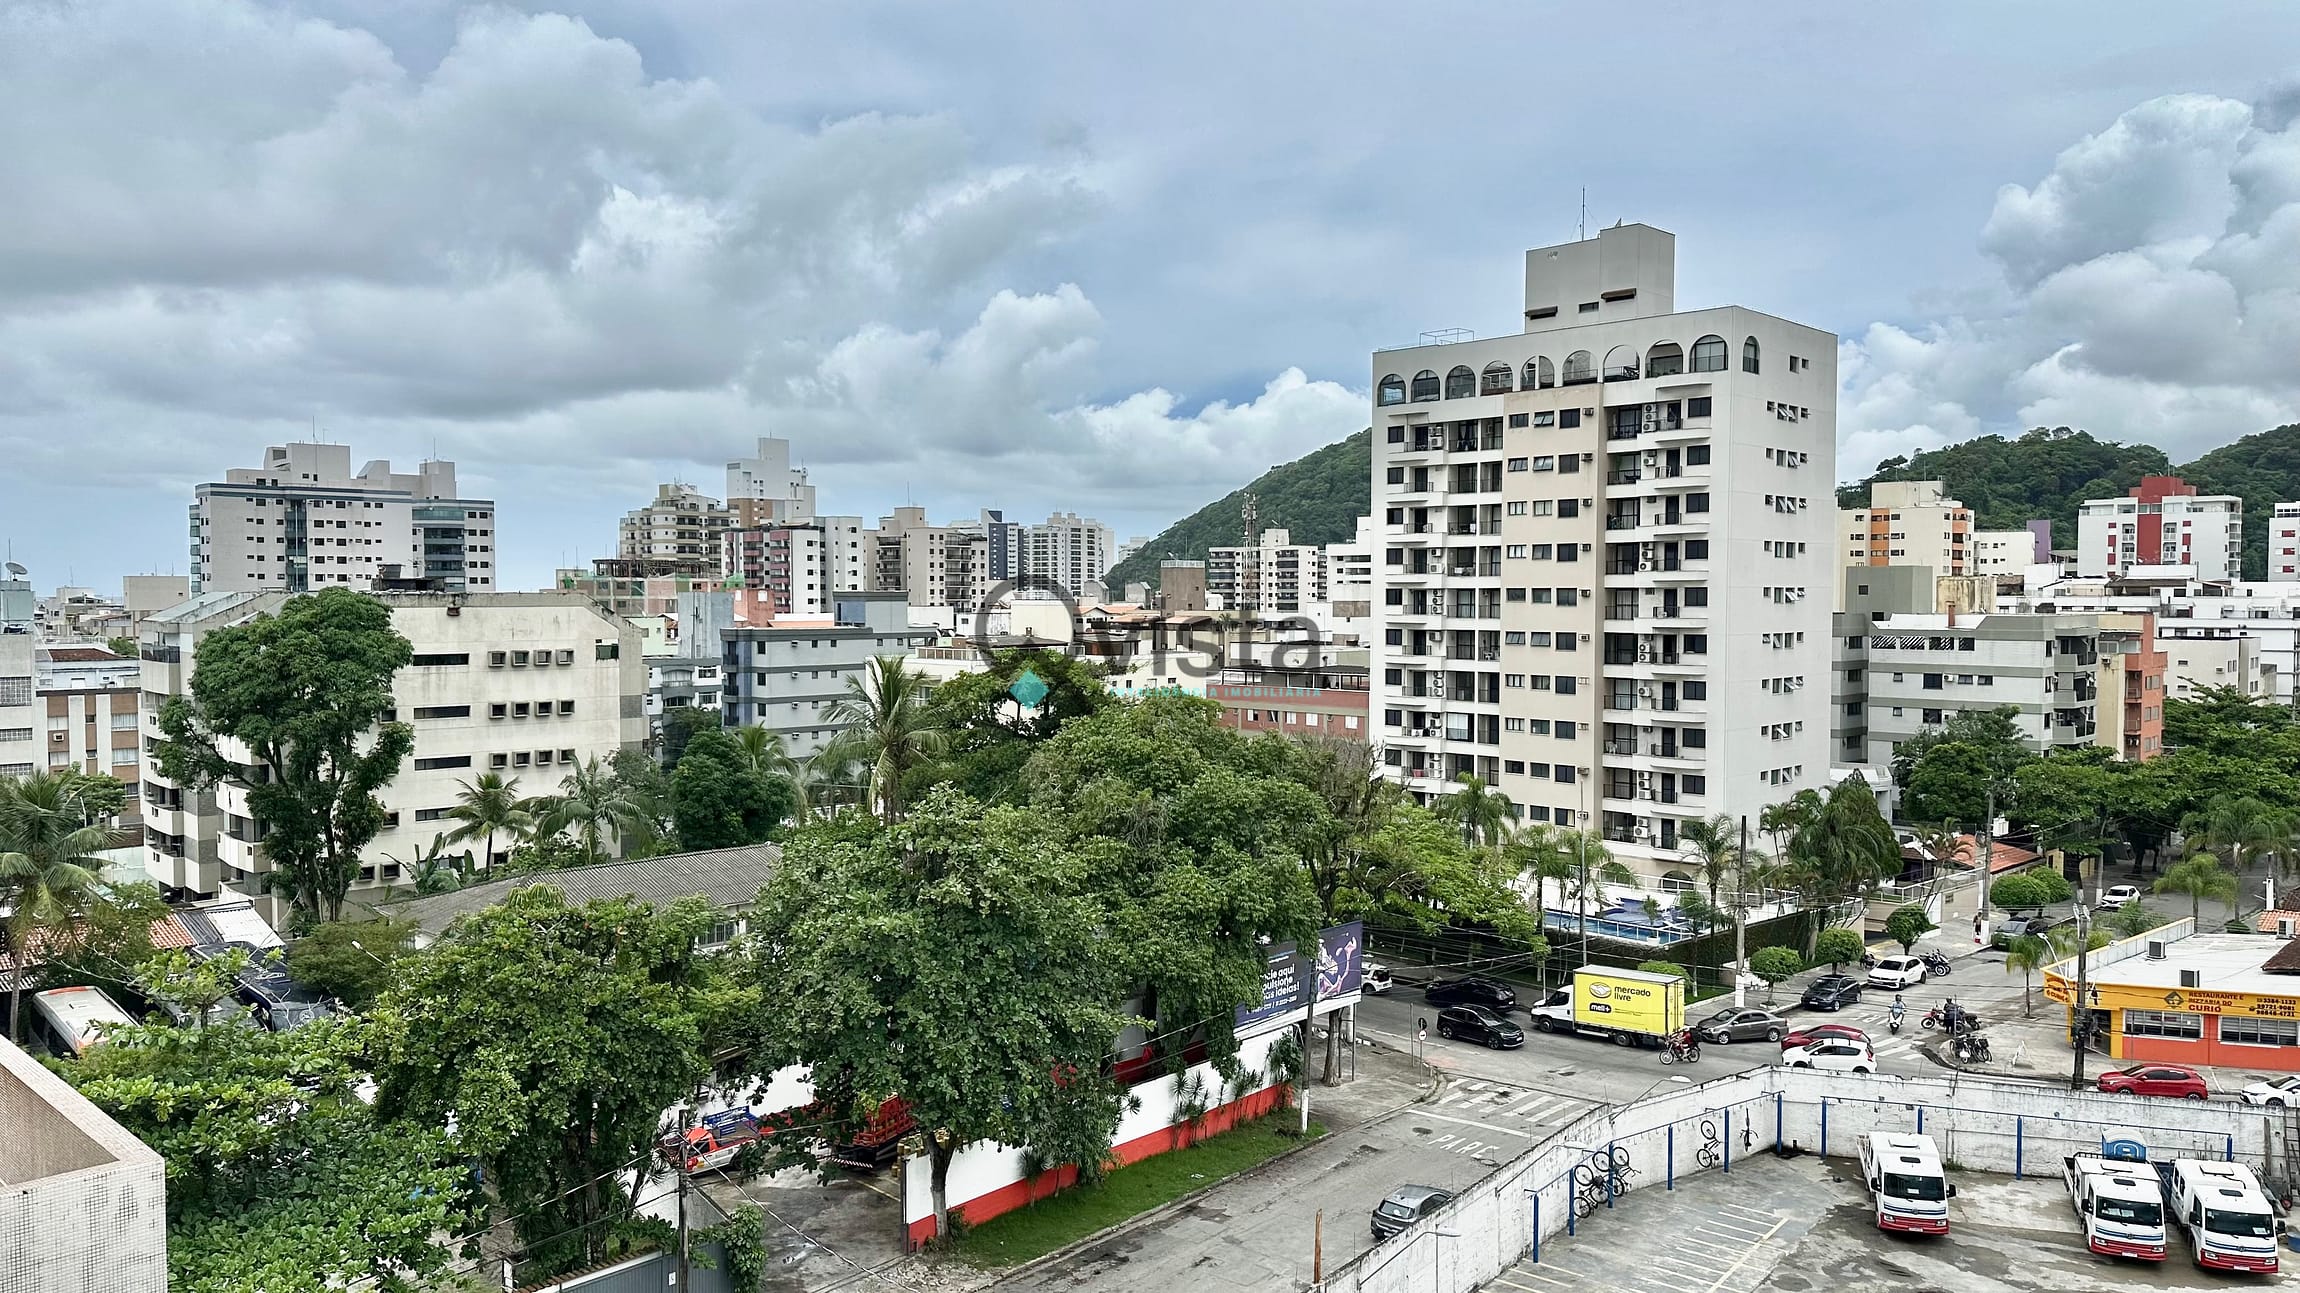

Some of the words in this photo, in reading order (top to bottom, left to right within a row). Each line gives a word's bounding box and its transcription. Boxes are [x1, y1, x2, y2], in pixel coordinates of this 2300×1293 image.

[1614, 986, 1651, 997] mercado
[1614, 993, 1631, 1001] livre
[1427, 1133, 1500, 1159] PARE
